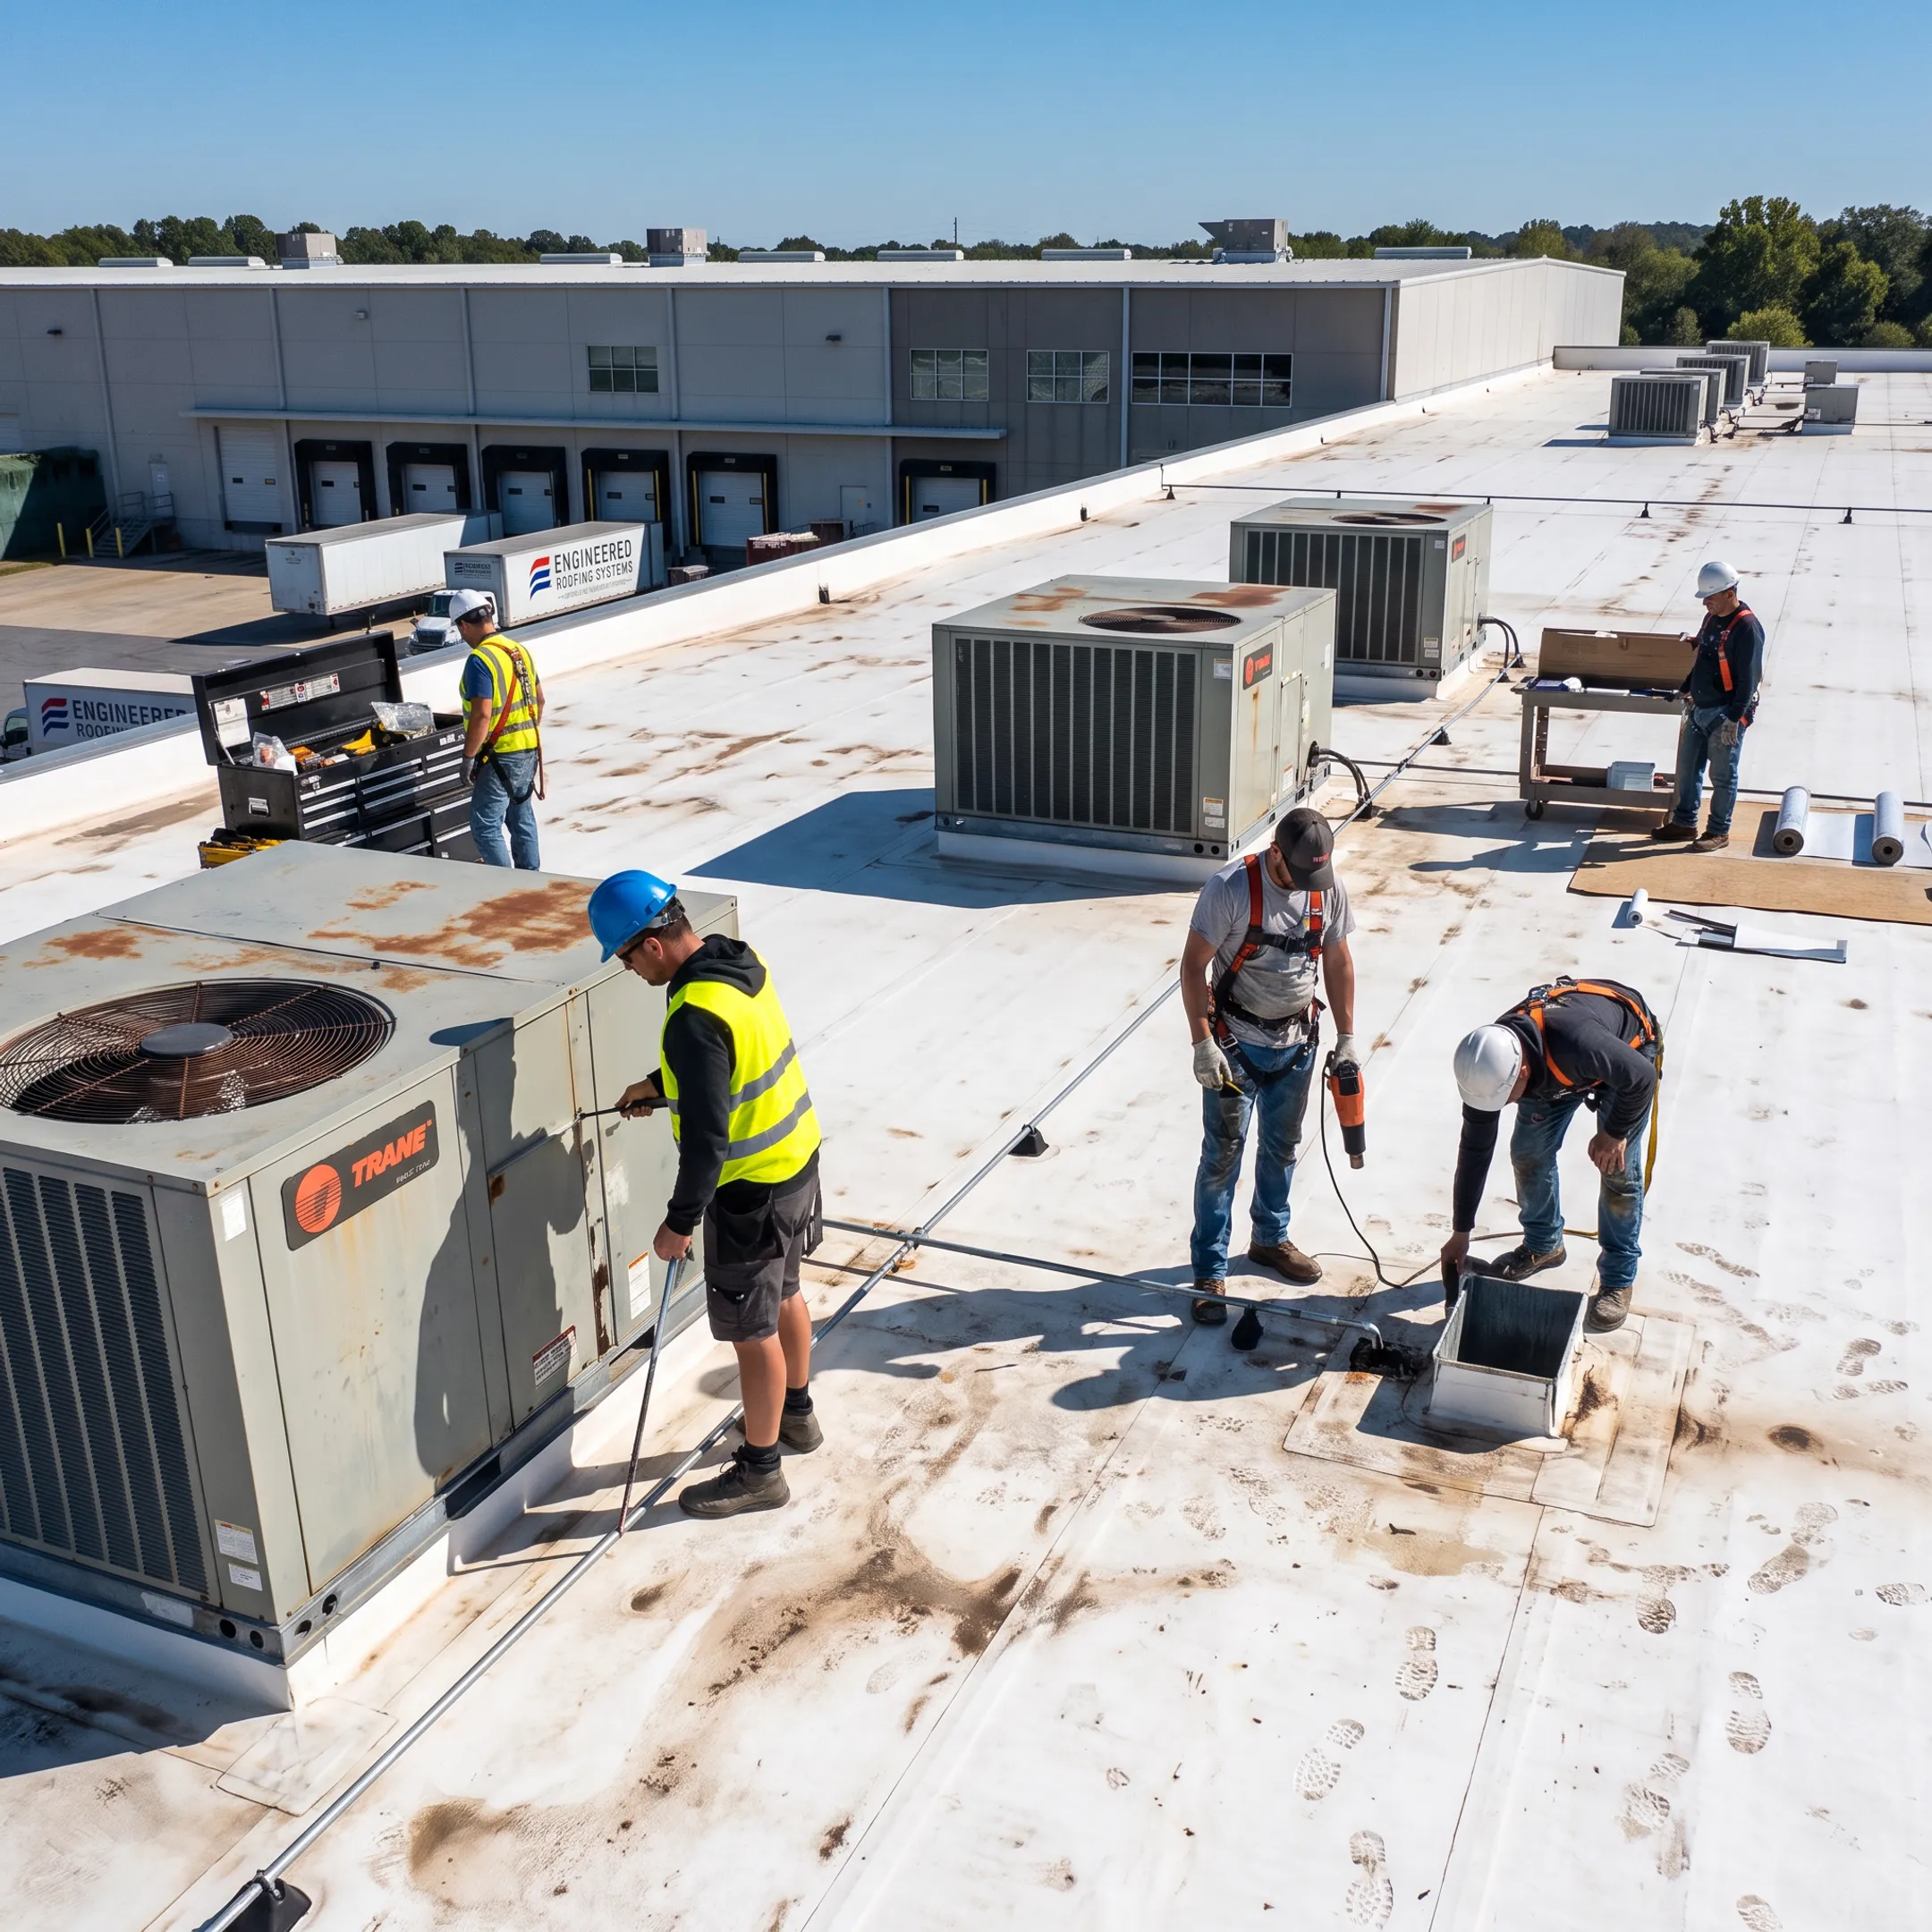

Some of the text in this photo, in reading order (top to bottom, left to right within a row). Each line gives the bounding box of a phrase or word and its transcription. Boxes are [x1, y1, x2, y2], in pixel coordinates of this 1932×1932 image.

[555, 539, 631, 573] ENGINEERED
[556, 570, 593, 590] ROOFING
[596, 561, 633, 581] SYSTEMS
[352, 1123, 427, 1188] TRANE
